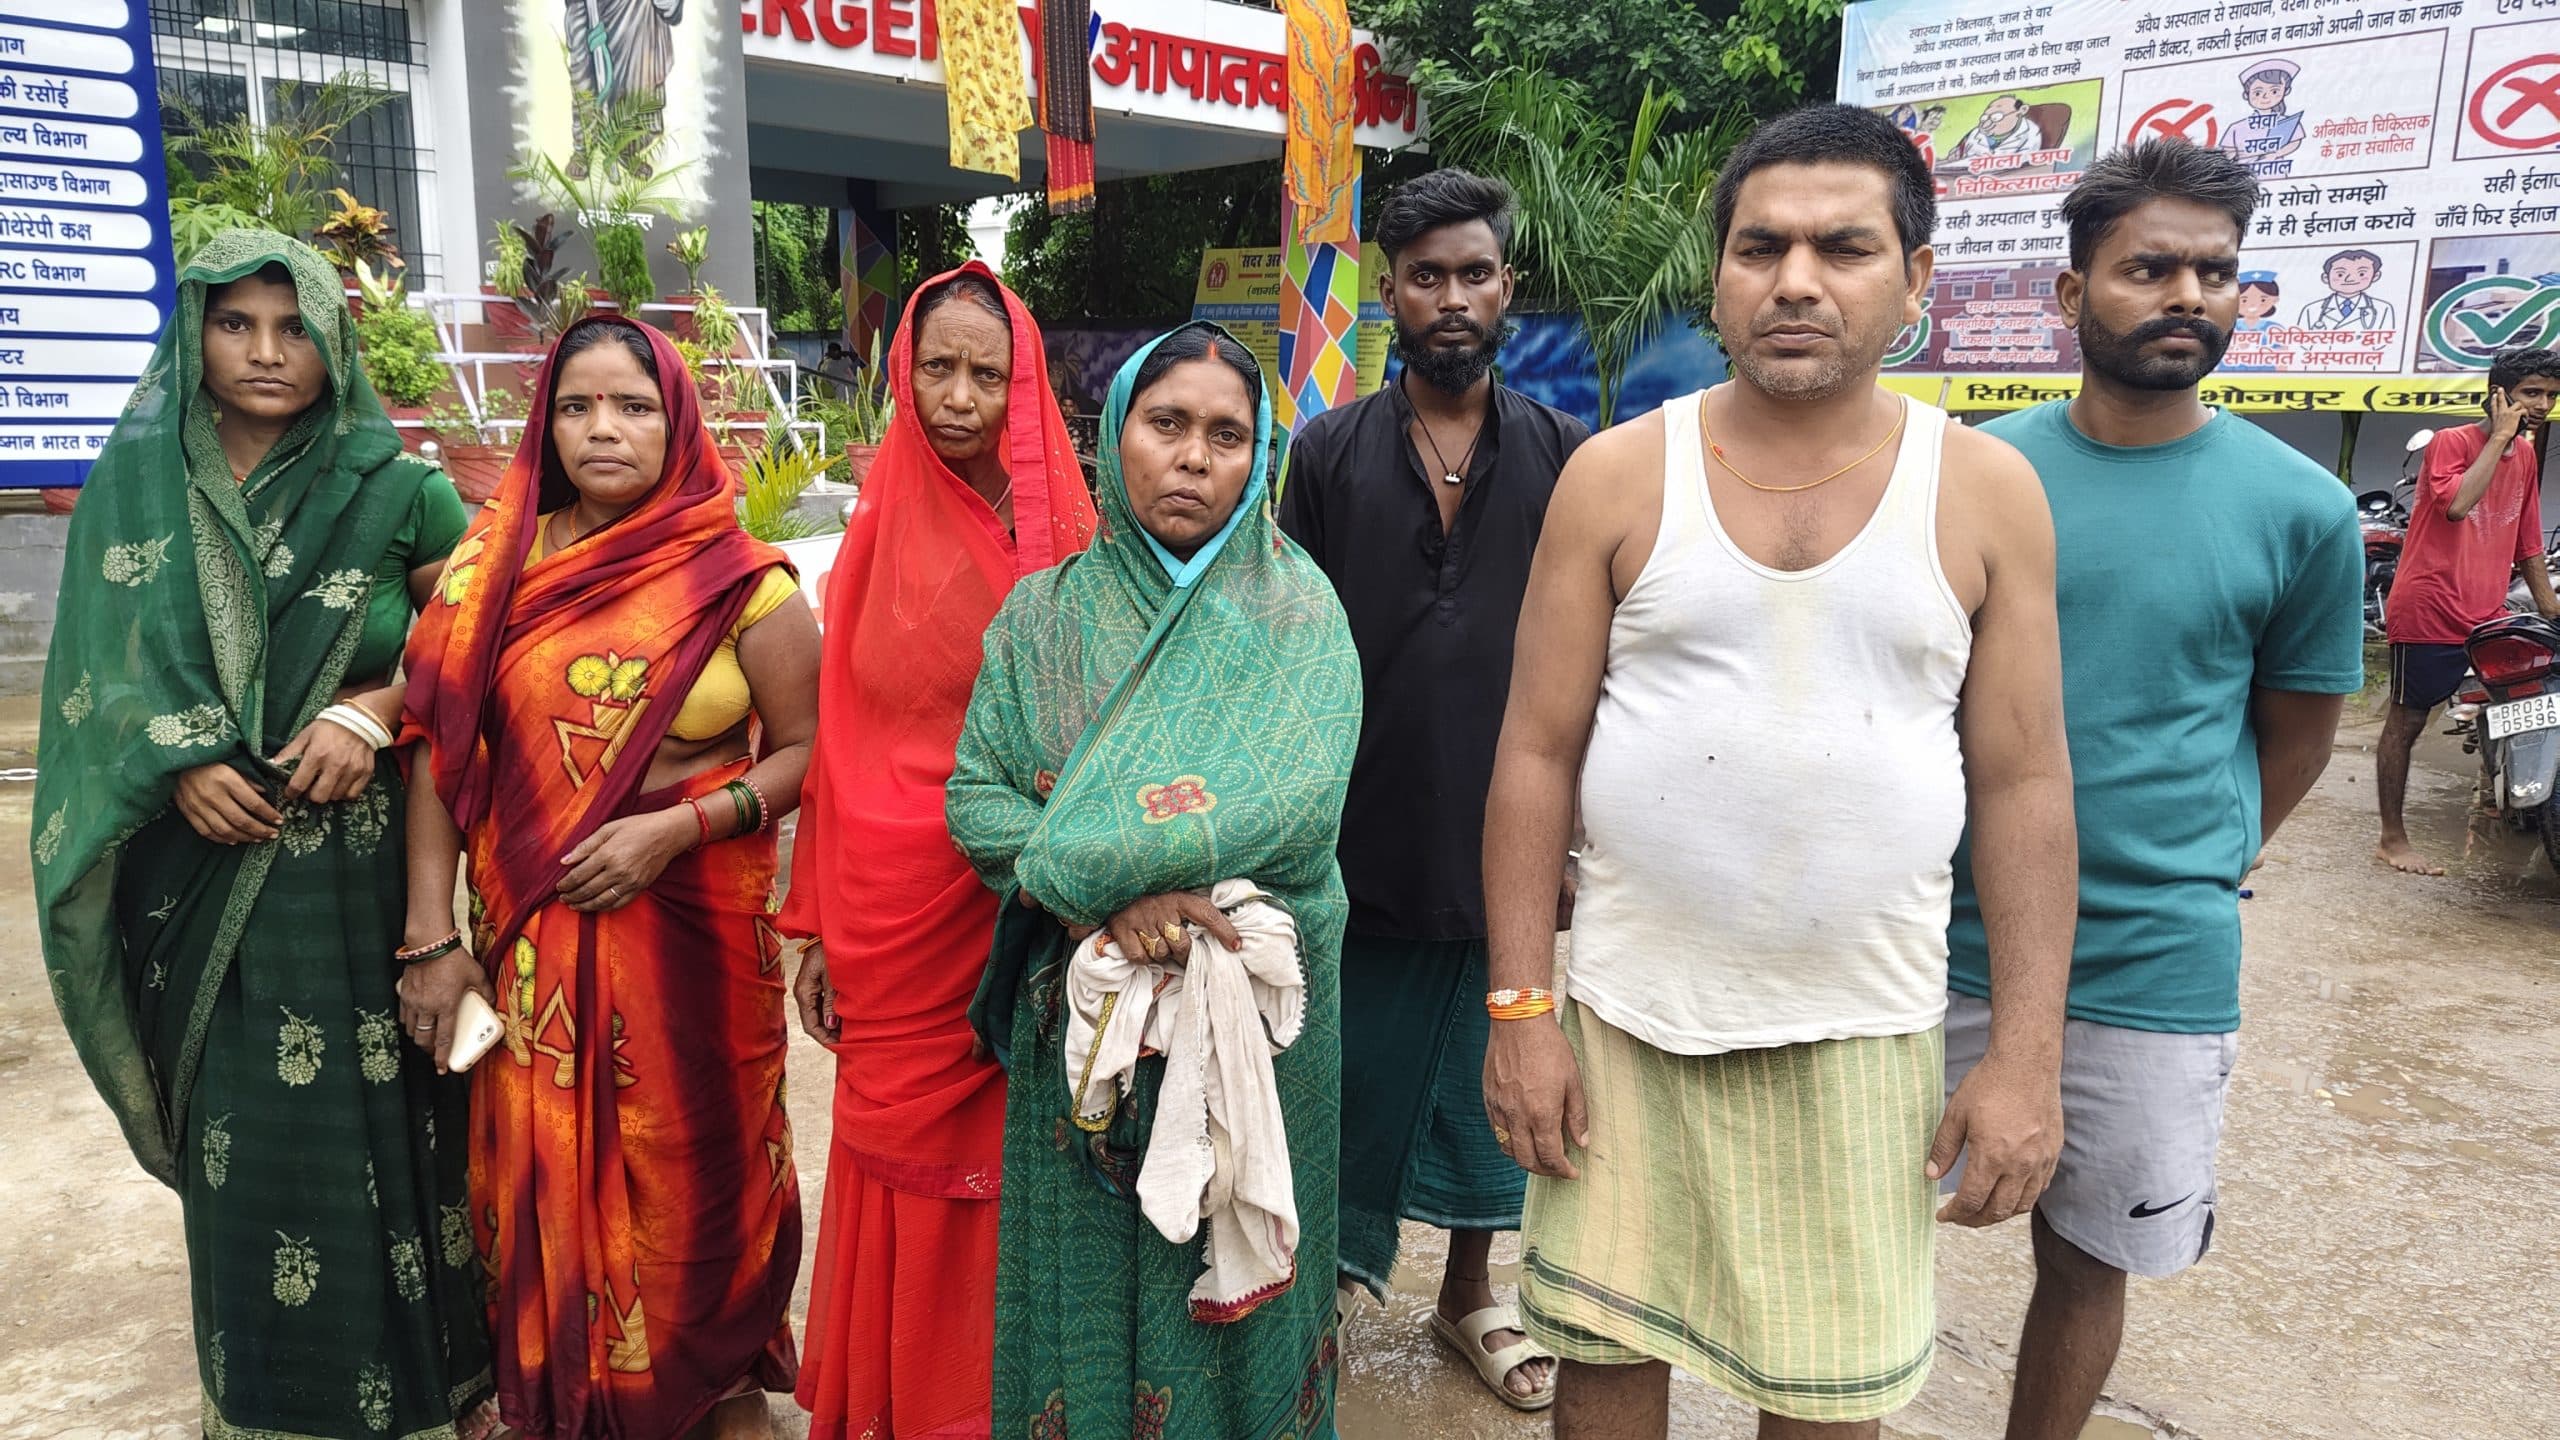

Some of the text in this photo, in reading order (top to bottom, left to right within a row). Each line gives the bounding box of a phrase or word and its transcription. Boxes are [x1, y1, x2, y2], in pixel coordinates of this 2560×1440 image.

[1944, 20, 1953, 33] से
[2000, 11, 2020, 24] जान
[2023, 6, 2033, 20] से
[2036, 6, 2053, 18] वार
[2164, 8, 2211, 30] अस्पताल
[2214, 1, 2225, 22] से
[2008, 28, 2021, 40] का
[2024, 23, 2044, 38] खेल
[2124, 39, 2156, 62] नकली
[2197, 28, 2231, 52] नकली
[2234, 25, 2268, 51] ईलाज
[2271, 27, 2283, 42] न
[2327, 9, 2364, 35] अपनी
[2367, 10, 2395, 30] जान
[2398, 7, 2416, 24] का
[2420, 1, 2464, 20] मजाक
[1944, 58, 1957, 69] का
[1959, 52, 2001, 67] अस्पताल
[2004, 49, 2025, 61] जान
[2028, 43, 2038, 58] के
[2041, 41, 2062, 56] लिए
[2086, 36, 2111, 49] जाल
[1937, 76, 1947, 90] से
[2003, 67, 2016, 81] की
[22, 79, 69, 109] रसोई
[2248, 110, 2278, 130] सेवा
[2372, 112, 2431, 134] चिकित्सक
[33, 122, 87, 150] विभाग
[2244, 137, 2282, 154] सदन
[1970, 149, 2072, 172] झोला छाप
[2320, 140, 2333, 159] के
[2336, 142, 2361, 160] द्वारा
[62, 170, 110, 195] विभाग
[1956, 173, 2082, 195] चिकित्सालय
[2484, 169, 2516, 194] सही
[2278, 184, 2322, 208] सोचो
[2328, 179, 2388, 205] समझो
[1945, 209, 1971, 230] सही
[1976, 208, 2037, 228] अस्पताल
[2256, 215, 2273, 236] में
[2278, 214, 2298, 236] ही
[2304, 211, 2358, 237] ईलाज
[2364, 207, 2417, 231] करावें
[2473, 203, 2504, 226] फिर
[2509, 200, 2560, 228] ईलाज
[59, 222, 91, 241] कक्ष
[1955, 236, 1993, 255] जीवन
[1997, 238, 2016, 252] का
[32, 258, 86, 282] विभाग
[2269, 326, 2355, 345] चिकित्सक
[2301, 351, 2384, 365] अस्पताल
[16, 386, 68, 408] विभाग
[1966, 384, 2076, 401] सिविल
[2200, 385, 2345, 411] भोजपुर
[42, 435, 80, 450] भारत
[2501, 696, 2555, 720] BR03A
